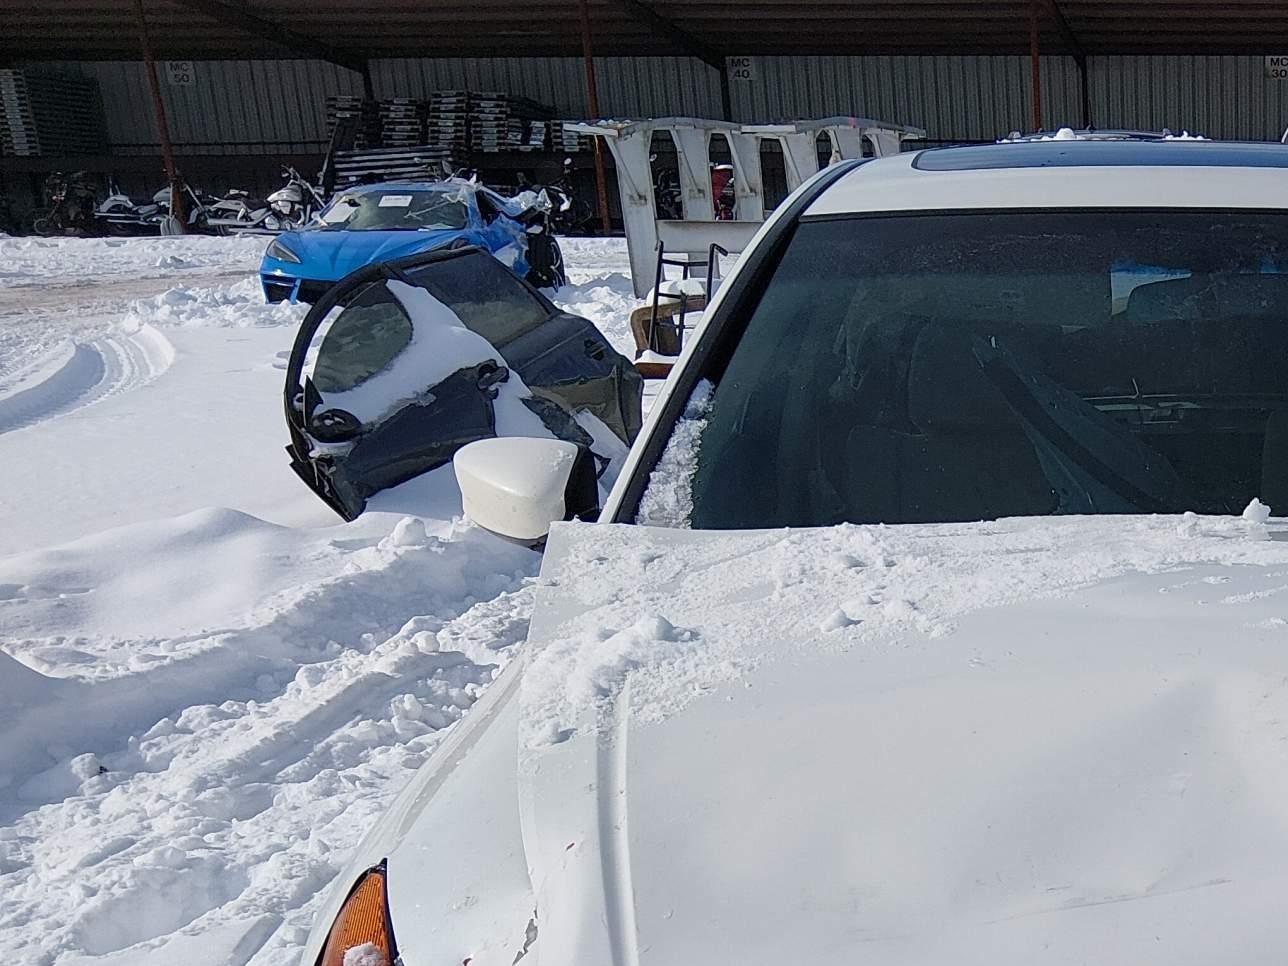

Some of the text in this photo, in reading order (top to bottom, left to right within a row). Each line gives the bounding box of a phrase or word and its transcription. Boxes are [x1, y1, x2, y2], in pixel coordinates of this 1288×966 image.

[731, 58, 751, 67] MC
[1270, 57, 1288, 67] MC
[169, 62, 190, 72] MC
[733, 69, 750, 78] 40
[1271, 69, 1288, 78] 30
[174, 74, 190, 83] 50
